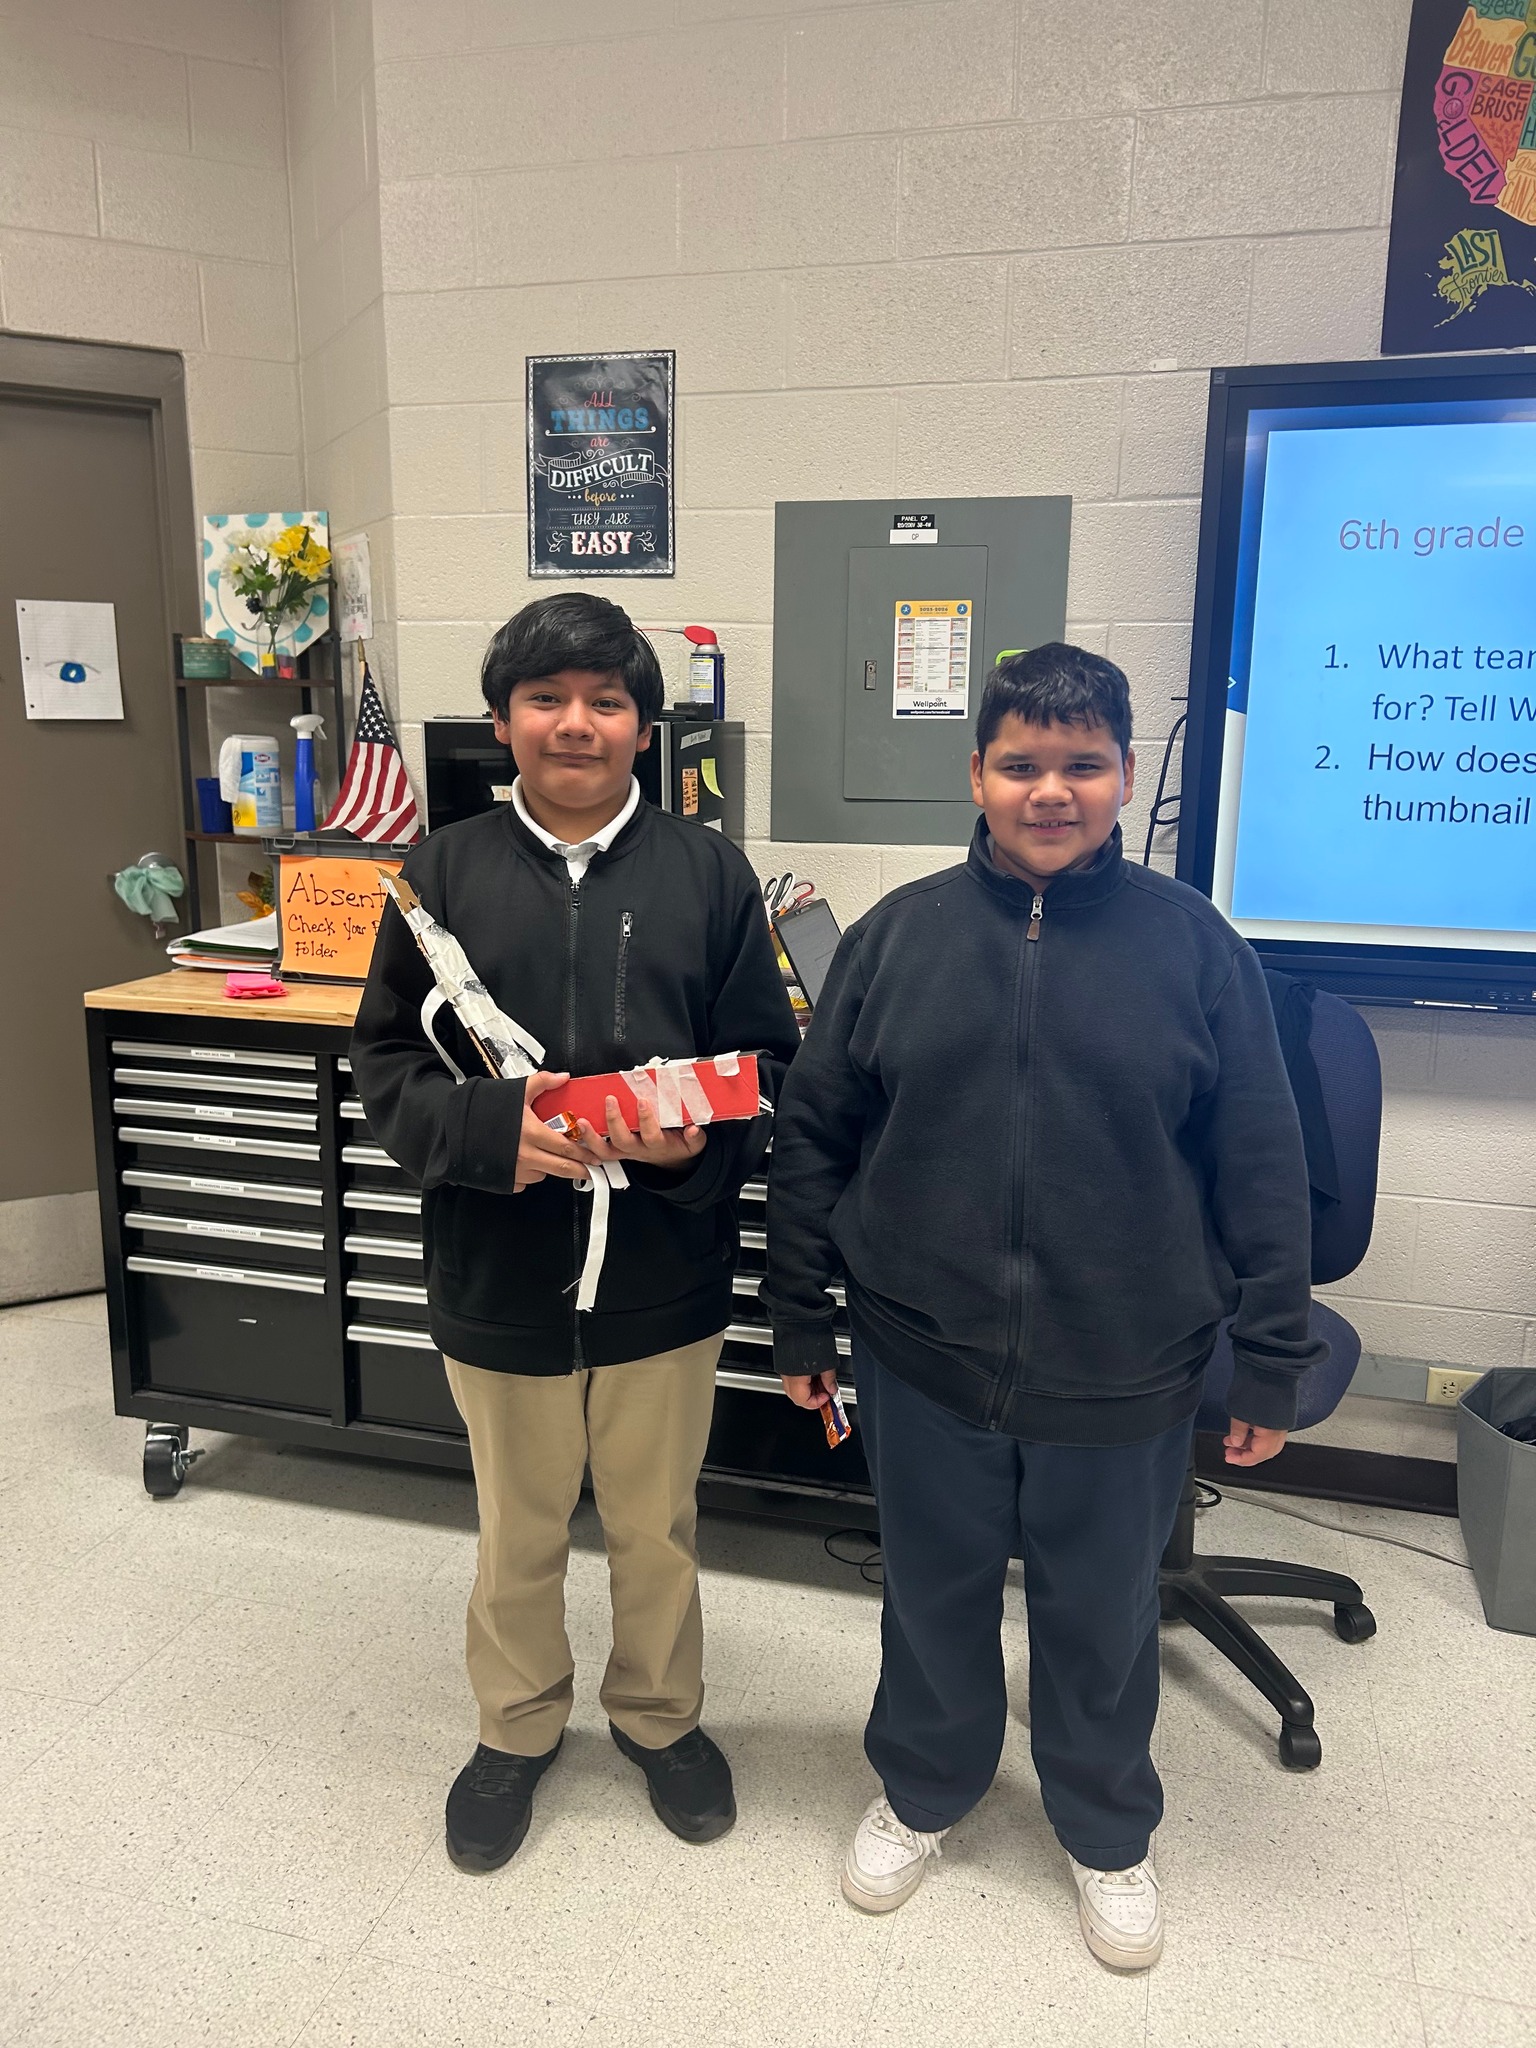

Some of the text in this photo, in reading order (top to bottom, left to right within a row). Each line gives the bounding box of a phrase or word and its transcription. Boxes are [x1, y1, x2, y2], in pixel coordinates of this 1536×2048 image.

[1448, 9, 1514, 74] BEAVER
[1480, 76, 1532, 101] SAGE
[1471, 93, 1528, 122] BRUSH
[1446, 231, 1497, 275] LAST
[551, 407, 650, 432] THINGS
[590, 437, 610, 448] are
[550, 453, 652, 488] DIFFICULT
[584, 488, 617, 507] before
[571, 512, 632, 526] THEY ARE
[571, 531, 634, 556] EASY
[1340, 516, 1525, 557] 6th grade
[1324, 644, 1349, 669] 1.
[1378, 642, 1464, 669] What
[912, 700, 948, 709] Wellpoint
[1372, 693, 1435, 721] for?
[1445, 694, 1497, 721] Tell
[1314, 743, 1536, 774] 2. How does
[1363, 793, 1531, 825] thumbnail
[286, 871, 387, 909] Absent
[288, 913, 336, 936] Check
[295, 941, 338, 958] Folder
